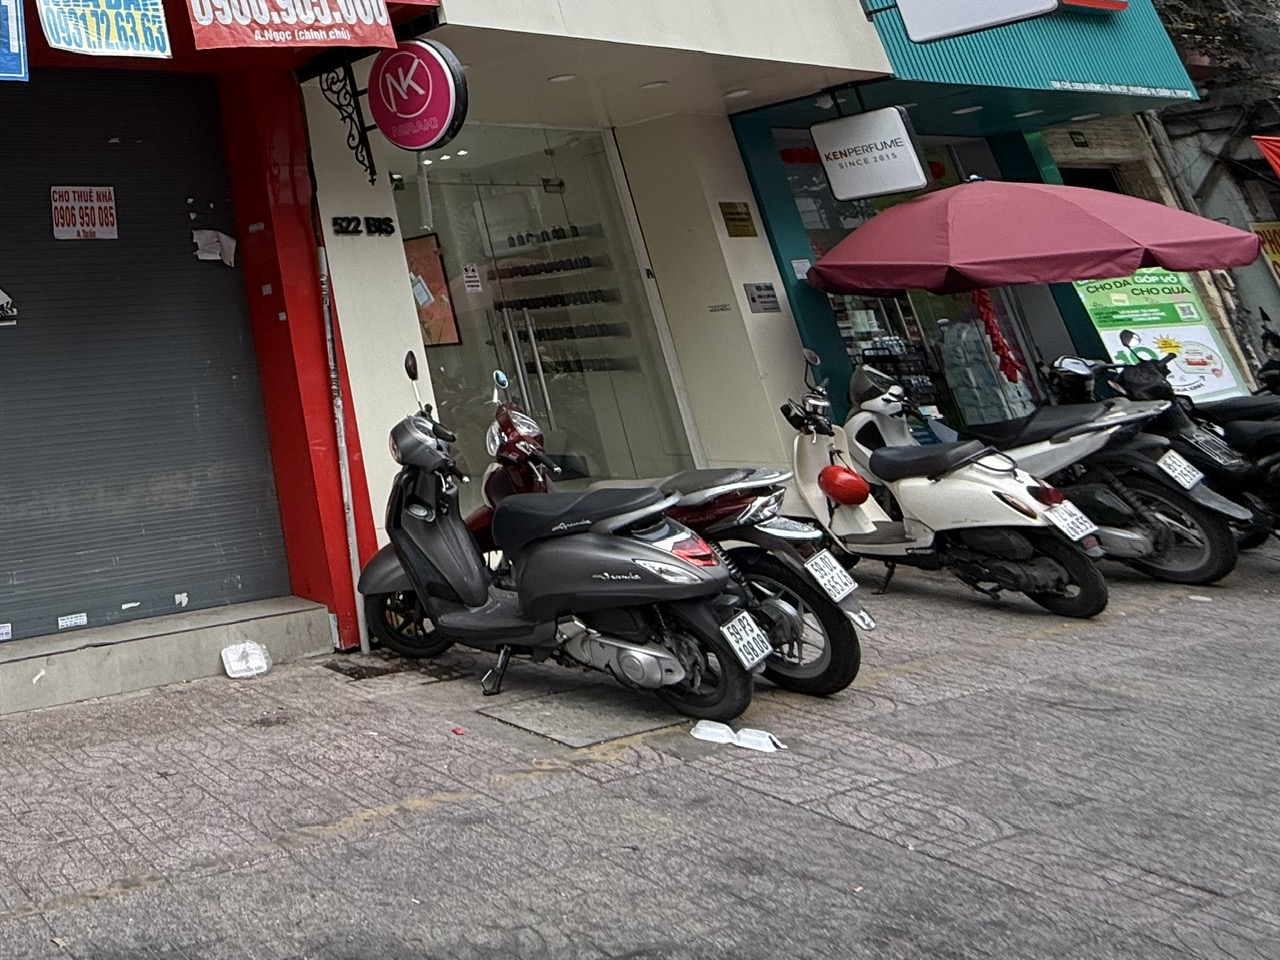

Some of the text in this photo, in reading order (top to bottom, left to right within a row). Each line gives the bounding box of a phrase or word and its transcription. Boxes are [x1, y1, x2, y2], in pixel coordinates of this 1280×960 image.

[824, 138, 904, 161] KENPERFUME
[839, 152, 897, 169] SINCE 2015
[53, 188, 113, 202] CHO THUÊ NHÀ
[54, 206, 114, 227] 0906 950 085
[332, 216, 395, 235] 522 BIS
[1086, 283, 1112, 293] CHO
[726, 615, 754, 644] 59-P3
[739, 633, 769, 664] 198.08
